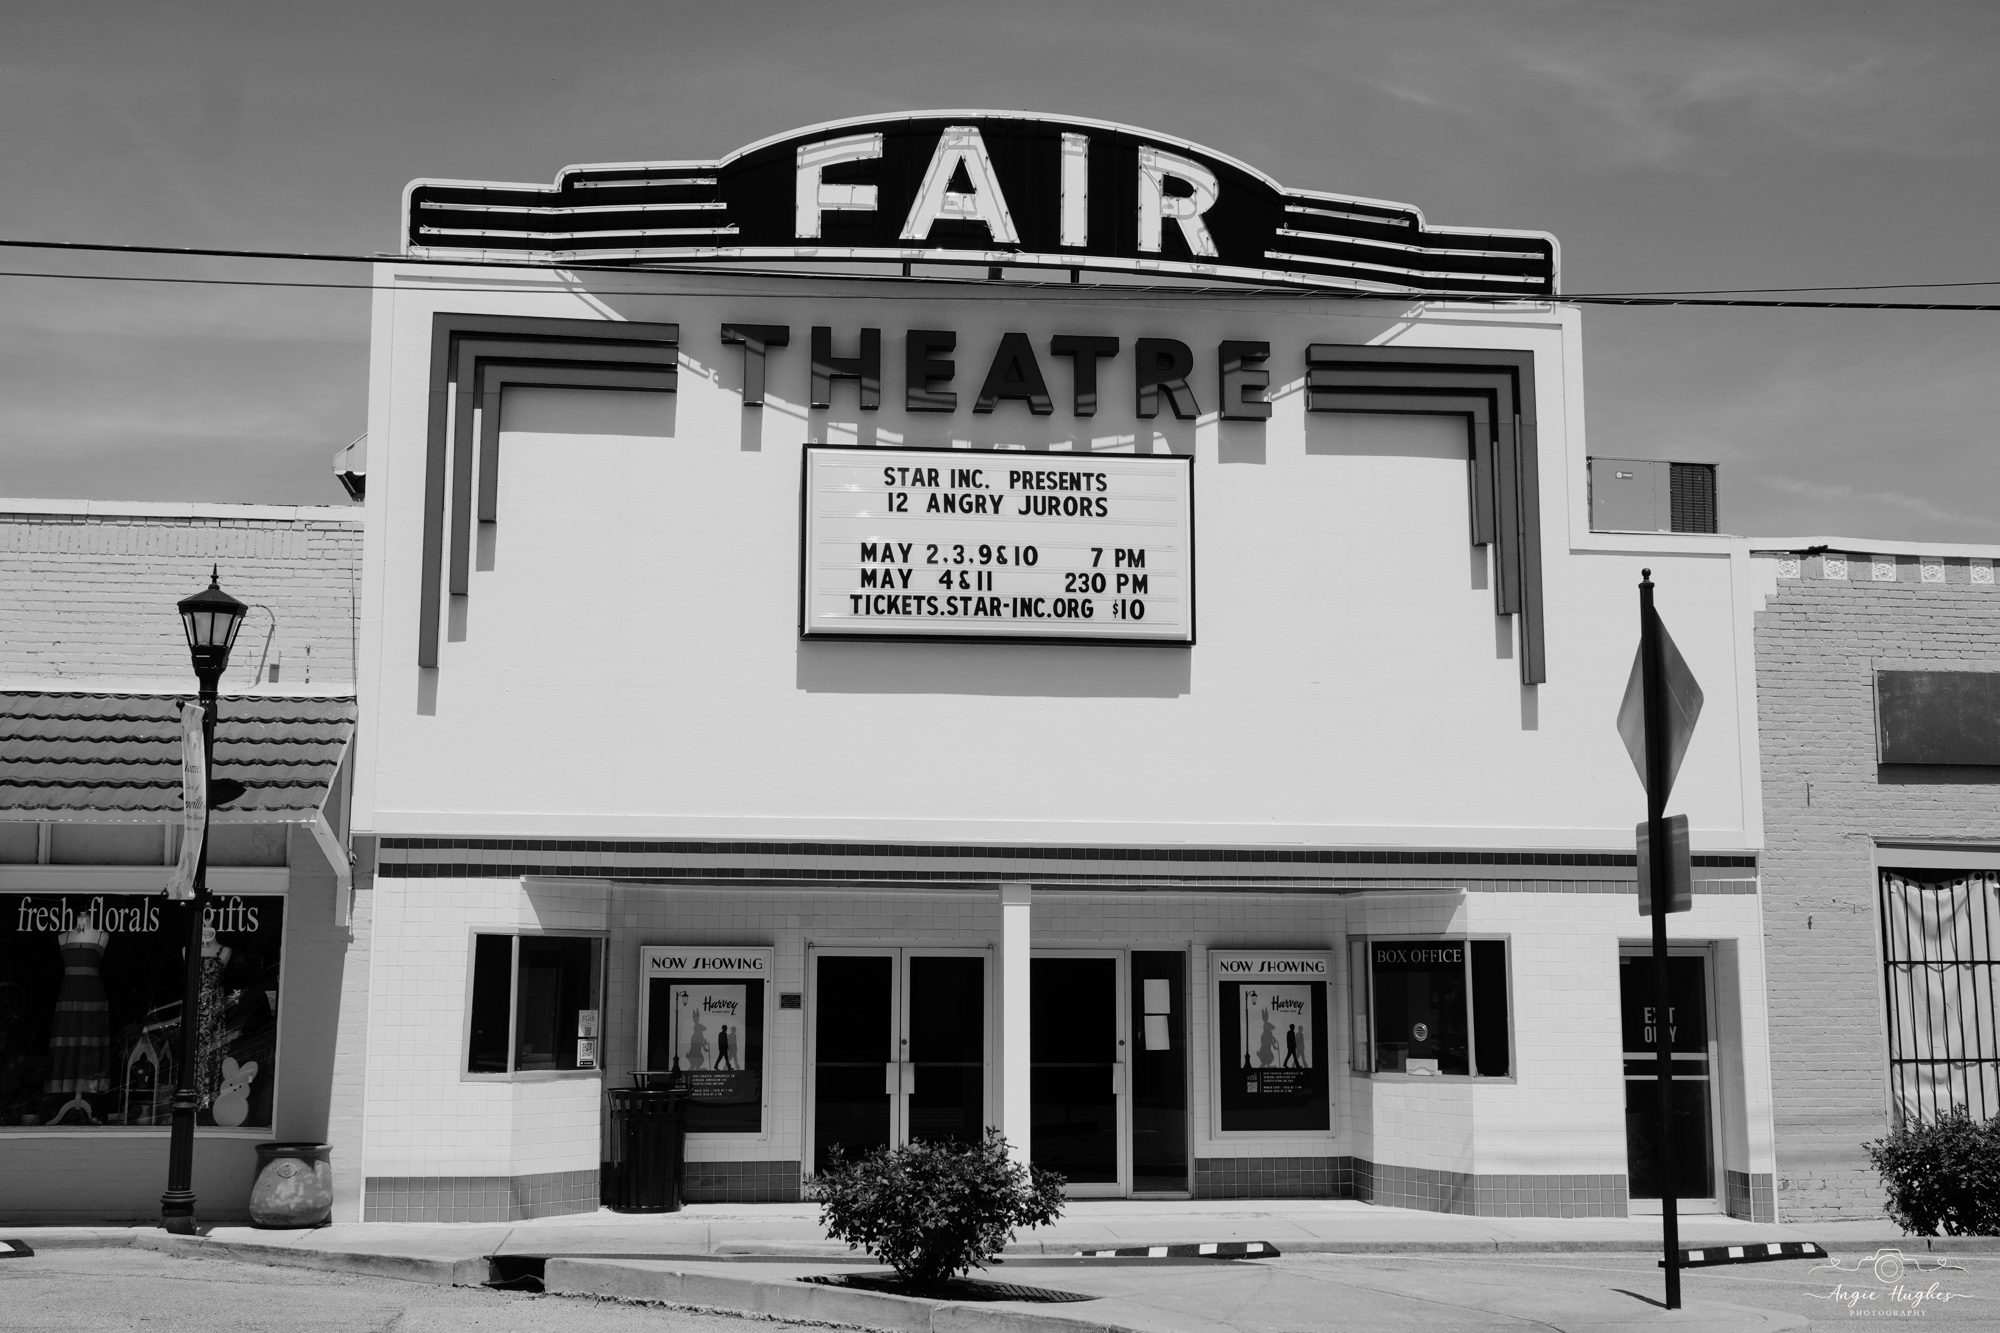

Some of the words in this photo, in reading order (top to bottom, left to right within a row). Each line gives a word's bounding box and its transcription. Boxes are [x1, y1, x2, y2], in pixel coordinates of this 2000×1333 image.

[795, 125, 1220, 258] FAIR
[720, 322, 1273, 422] THEATRE
[883, 466, 940, 487] STAR
[950, 468, 990, 489] INC.
[1009, 470, 1108, 492] PRESENTS
[888, 492, 909, 513] 12
[926, 493, 1004, 514] ANGRY
[1018, 495, 1108, 518] JURORS
[861, 542, 913, 563] MAY
[1091, 547, 1104, 567] 7
[1114, 548, 1146, 568] PM
[861, 568, 913, 589] MAY
[1065, 572, 1107, 594] 230
[1116, 574, 1148, 594] PM
[849, 594, 1094, 619] TICKETS.STAR-INC.ORG
[1112, 599, 1145, 620] $10
[16, 896, 76, 932] fresh
[88, 896, 160, 932] florals
[202, 895, 259, 942] gifts
[651, 957, 688, 969] NOW
[692, 957, 763, 970] SHOWING
[1220, 960, 1254, 972] NOW
[1258, 960, 1325, 973] SHOWING
[1377, 949, 1407, 963] BOX
[1410, 949, 1462, 963] OFFICE
[703, 994, 739, 1016] Harvey
[1271, 994, 1305, 1015] Harvey
